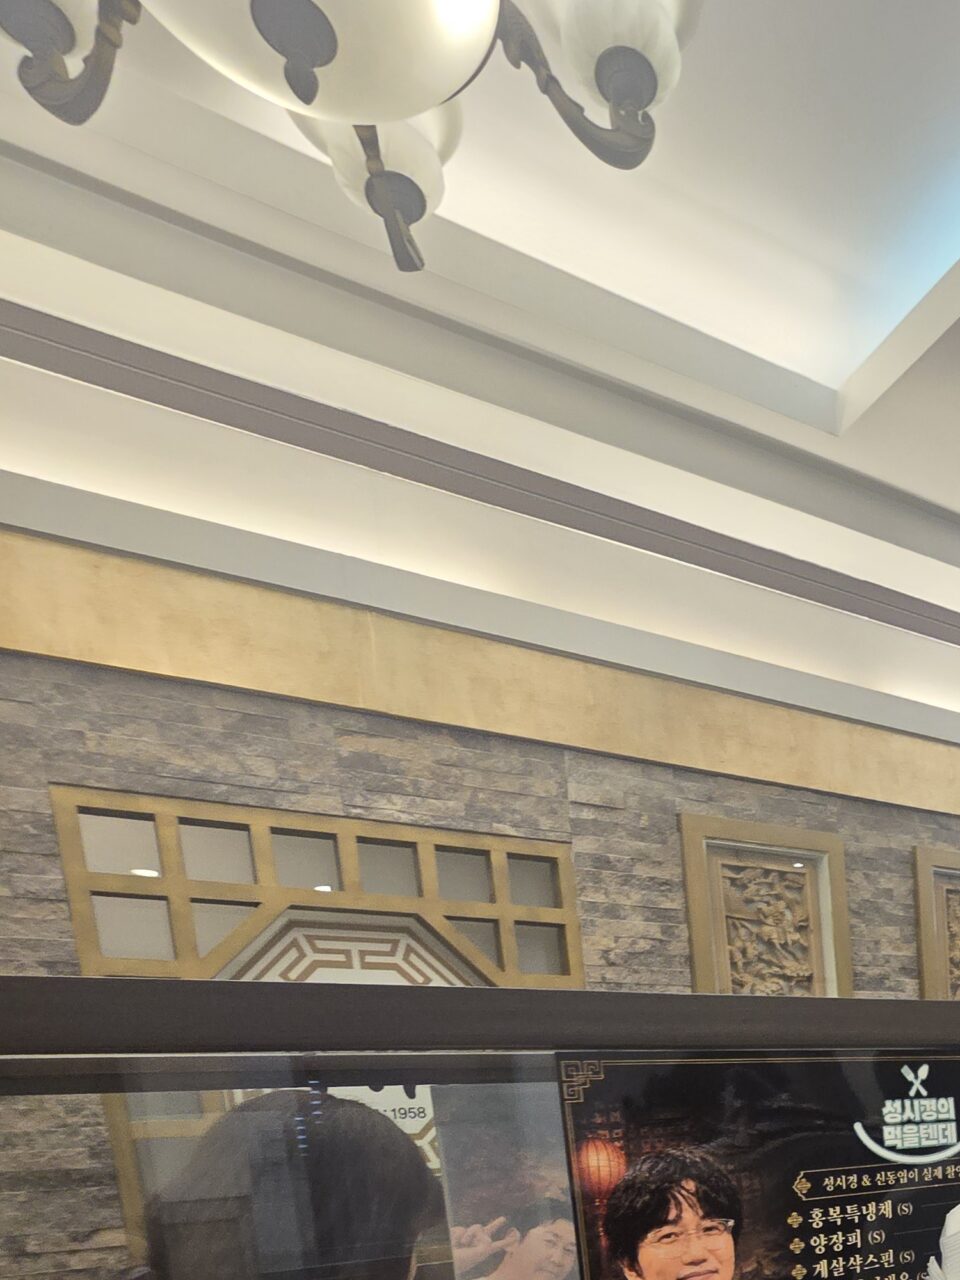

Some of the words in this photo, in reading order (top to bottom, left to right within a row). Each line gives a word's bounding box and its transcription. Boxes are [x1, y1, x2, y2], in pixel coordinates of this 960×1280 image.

[882, 1097, 956, 1124] 성시경의
[883, 1122, 957, 1149] 먹을텐데
[822, 1170, 858, 1192] 성시경
[861, 1174, 871, 1186] &
[875, 1164, 919, 1187] 신동엽이
[922, 1163, 943, 1181] 실제
[808, 1199, 893, 1229] 홍복특냉채
[897, 1202, 914, 1216] (S)
[810, 1228, 862, 1255] 양장피
[868, 1229, 886, 1245] (S)
[813, 1249, 896, 1279] 게살샥스핀
[899, 1250, 916, 1264] (S)
